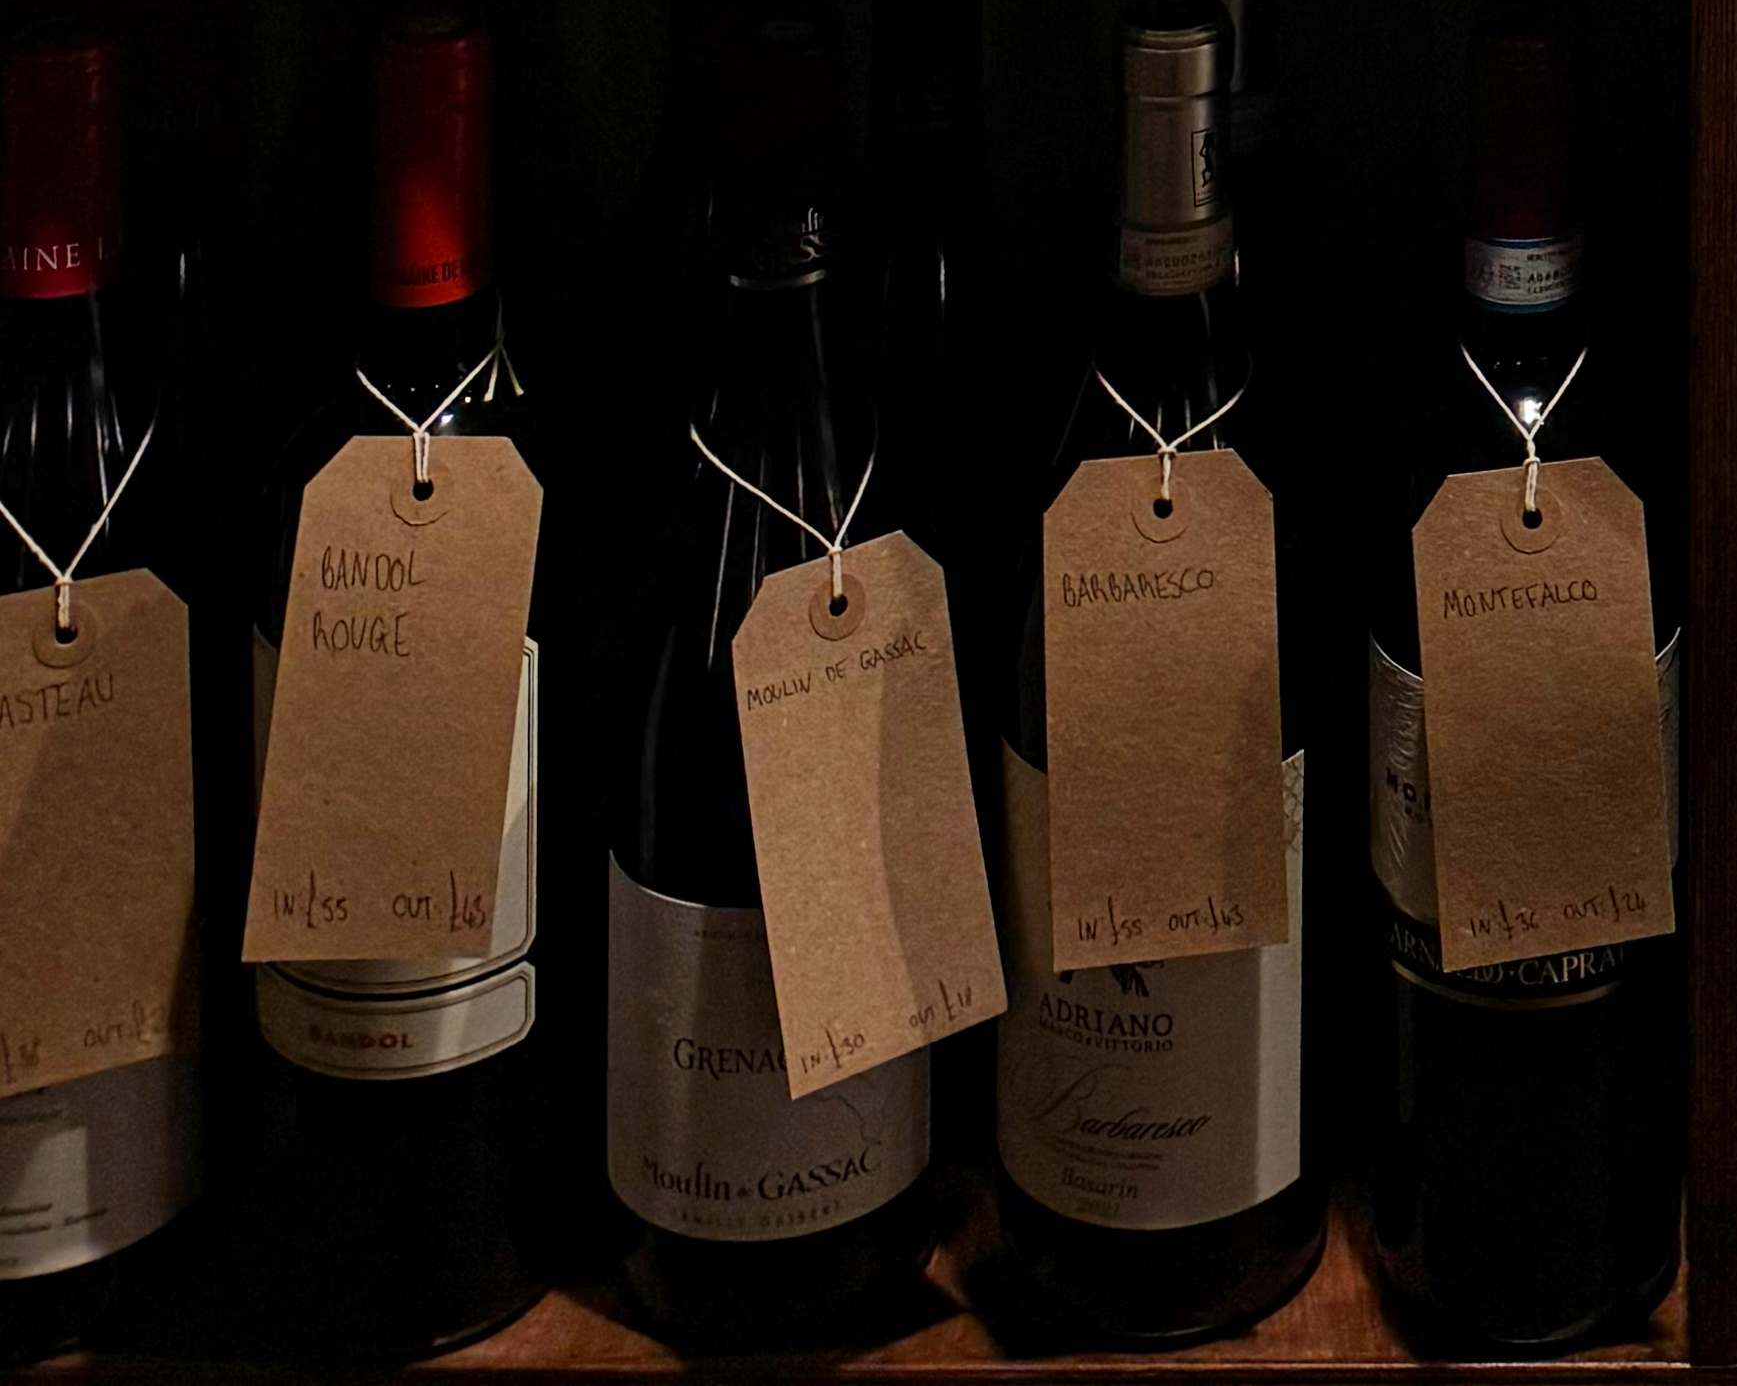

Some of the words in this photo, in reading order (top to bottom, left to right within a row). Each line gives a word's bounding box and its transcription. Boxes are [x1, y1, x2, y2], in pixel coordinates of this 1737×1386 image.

[321, 545, 426, 592] BANDOL
[1062, 567, 1214, 608] BARBARESCO
[1443, 580, 1598, 620] MONTEFALCO
[312, 612, 411, 659] ROUGE
[745, 669, 812, 712] MOULIN
[826, 658, 847, 683] DE
[859, 633, 929, 671] GASSAC
[1039, 992, 1174, 1038] ADRIANO
[757, 1142, 882, 1204] GASSAC
